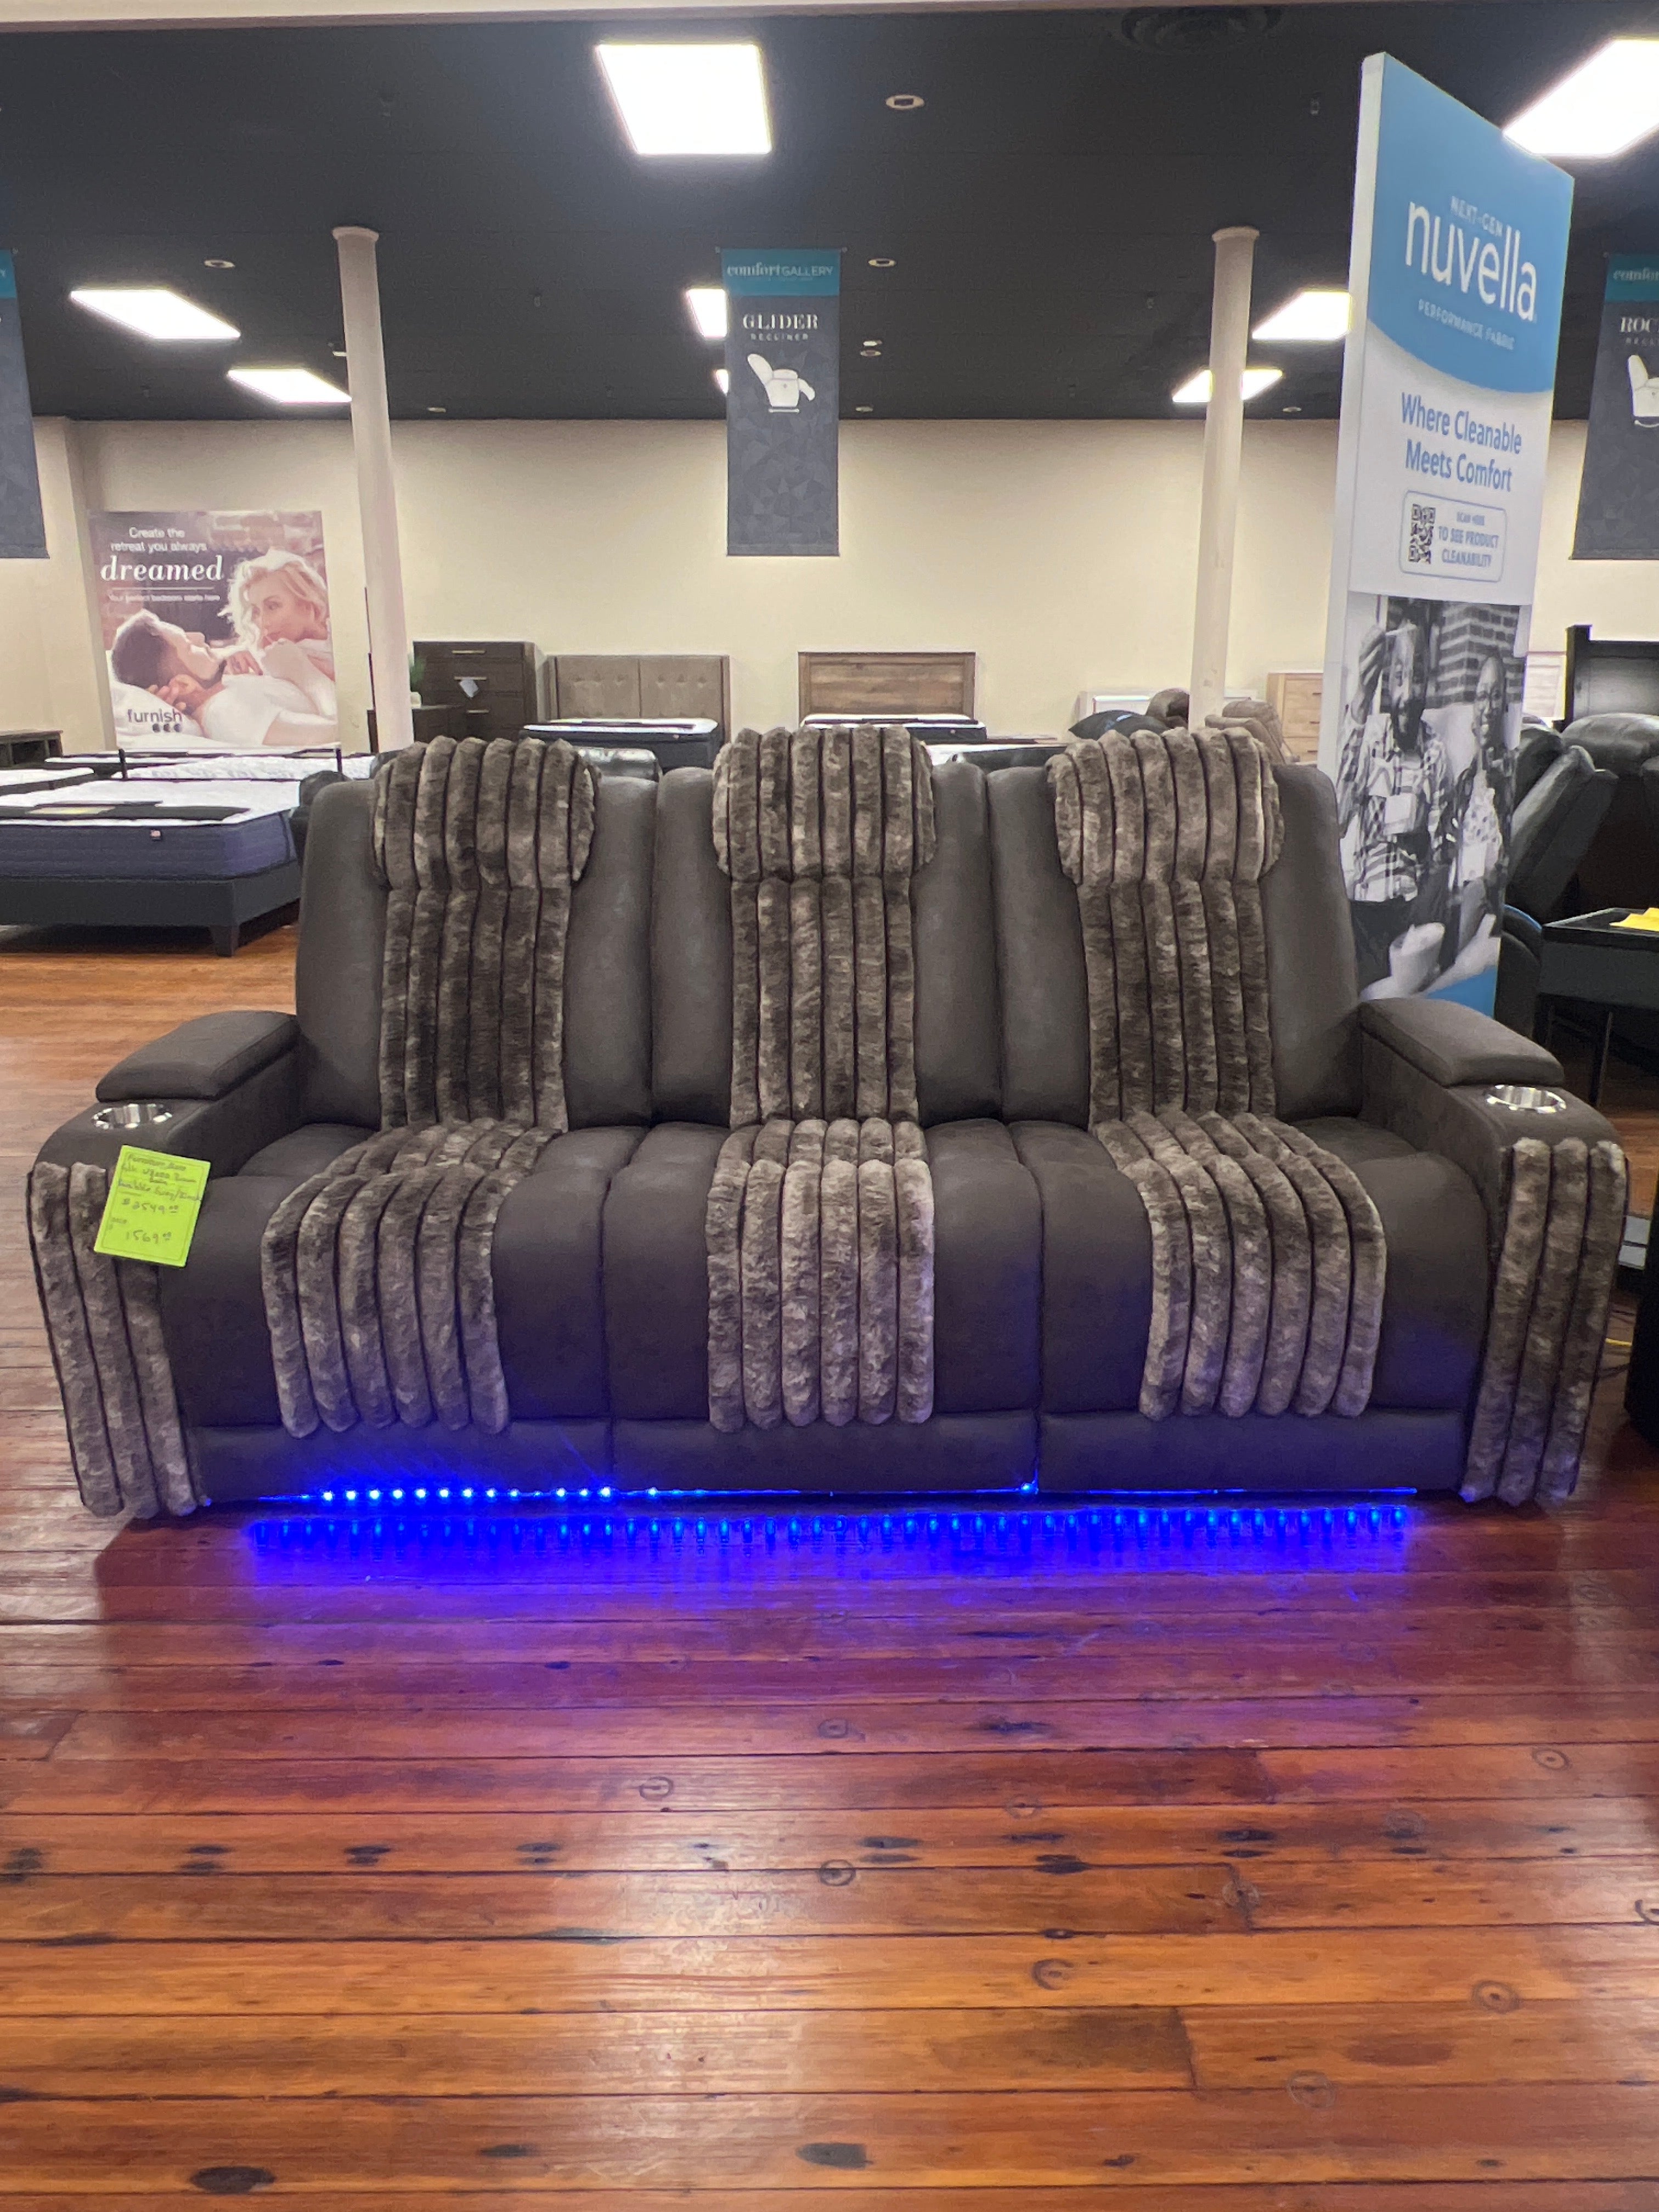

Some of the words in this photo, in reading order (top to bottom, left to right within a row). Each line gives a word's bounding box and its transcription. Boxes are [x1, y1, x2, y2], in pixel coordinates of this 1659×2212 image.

[1405, 201, 1536, 321] nuvella
[743, 313, 819, 330] GLIDER
[1402, 392, 1450, 436] Where
[1455, 410, 1522, 454] Cleanable
[1406, 438, 1452, 478] Meets
[1457, 453, 1512, 492] Comfort
[129, 527, 165, 538] Create
[167, 528, 185, 538] the
[1438, 526, 1448, 541] TO
[1465, 531, 1499, 548] PRODUCT
[111, 541, 145, 552] retreat
[148, 544, 168, 554] you
[170, 541, 207, 554] always
[100, 554, 224, 581] dreamed
[127, 708, 183, 723] furnish
